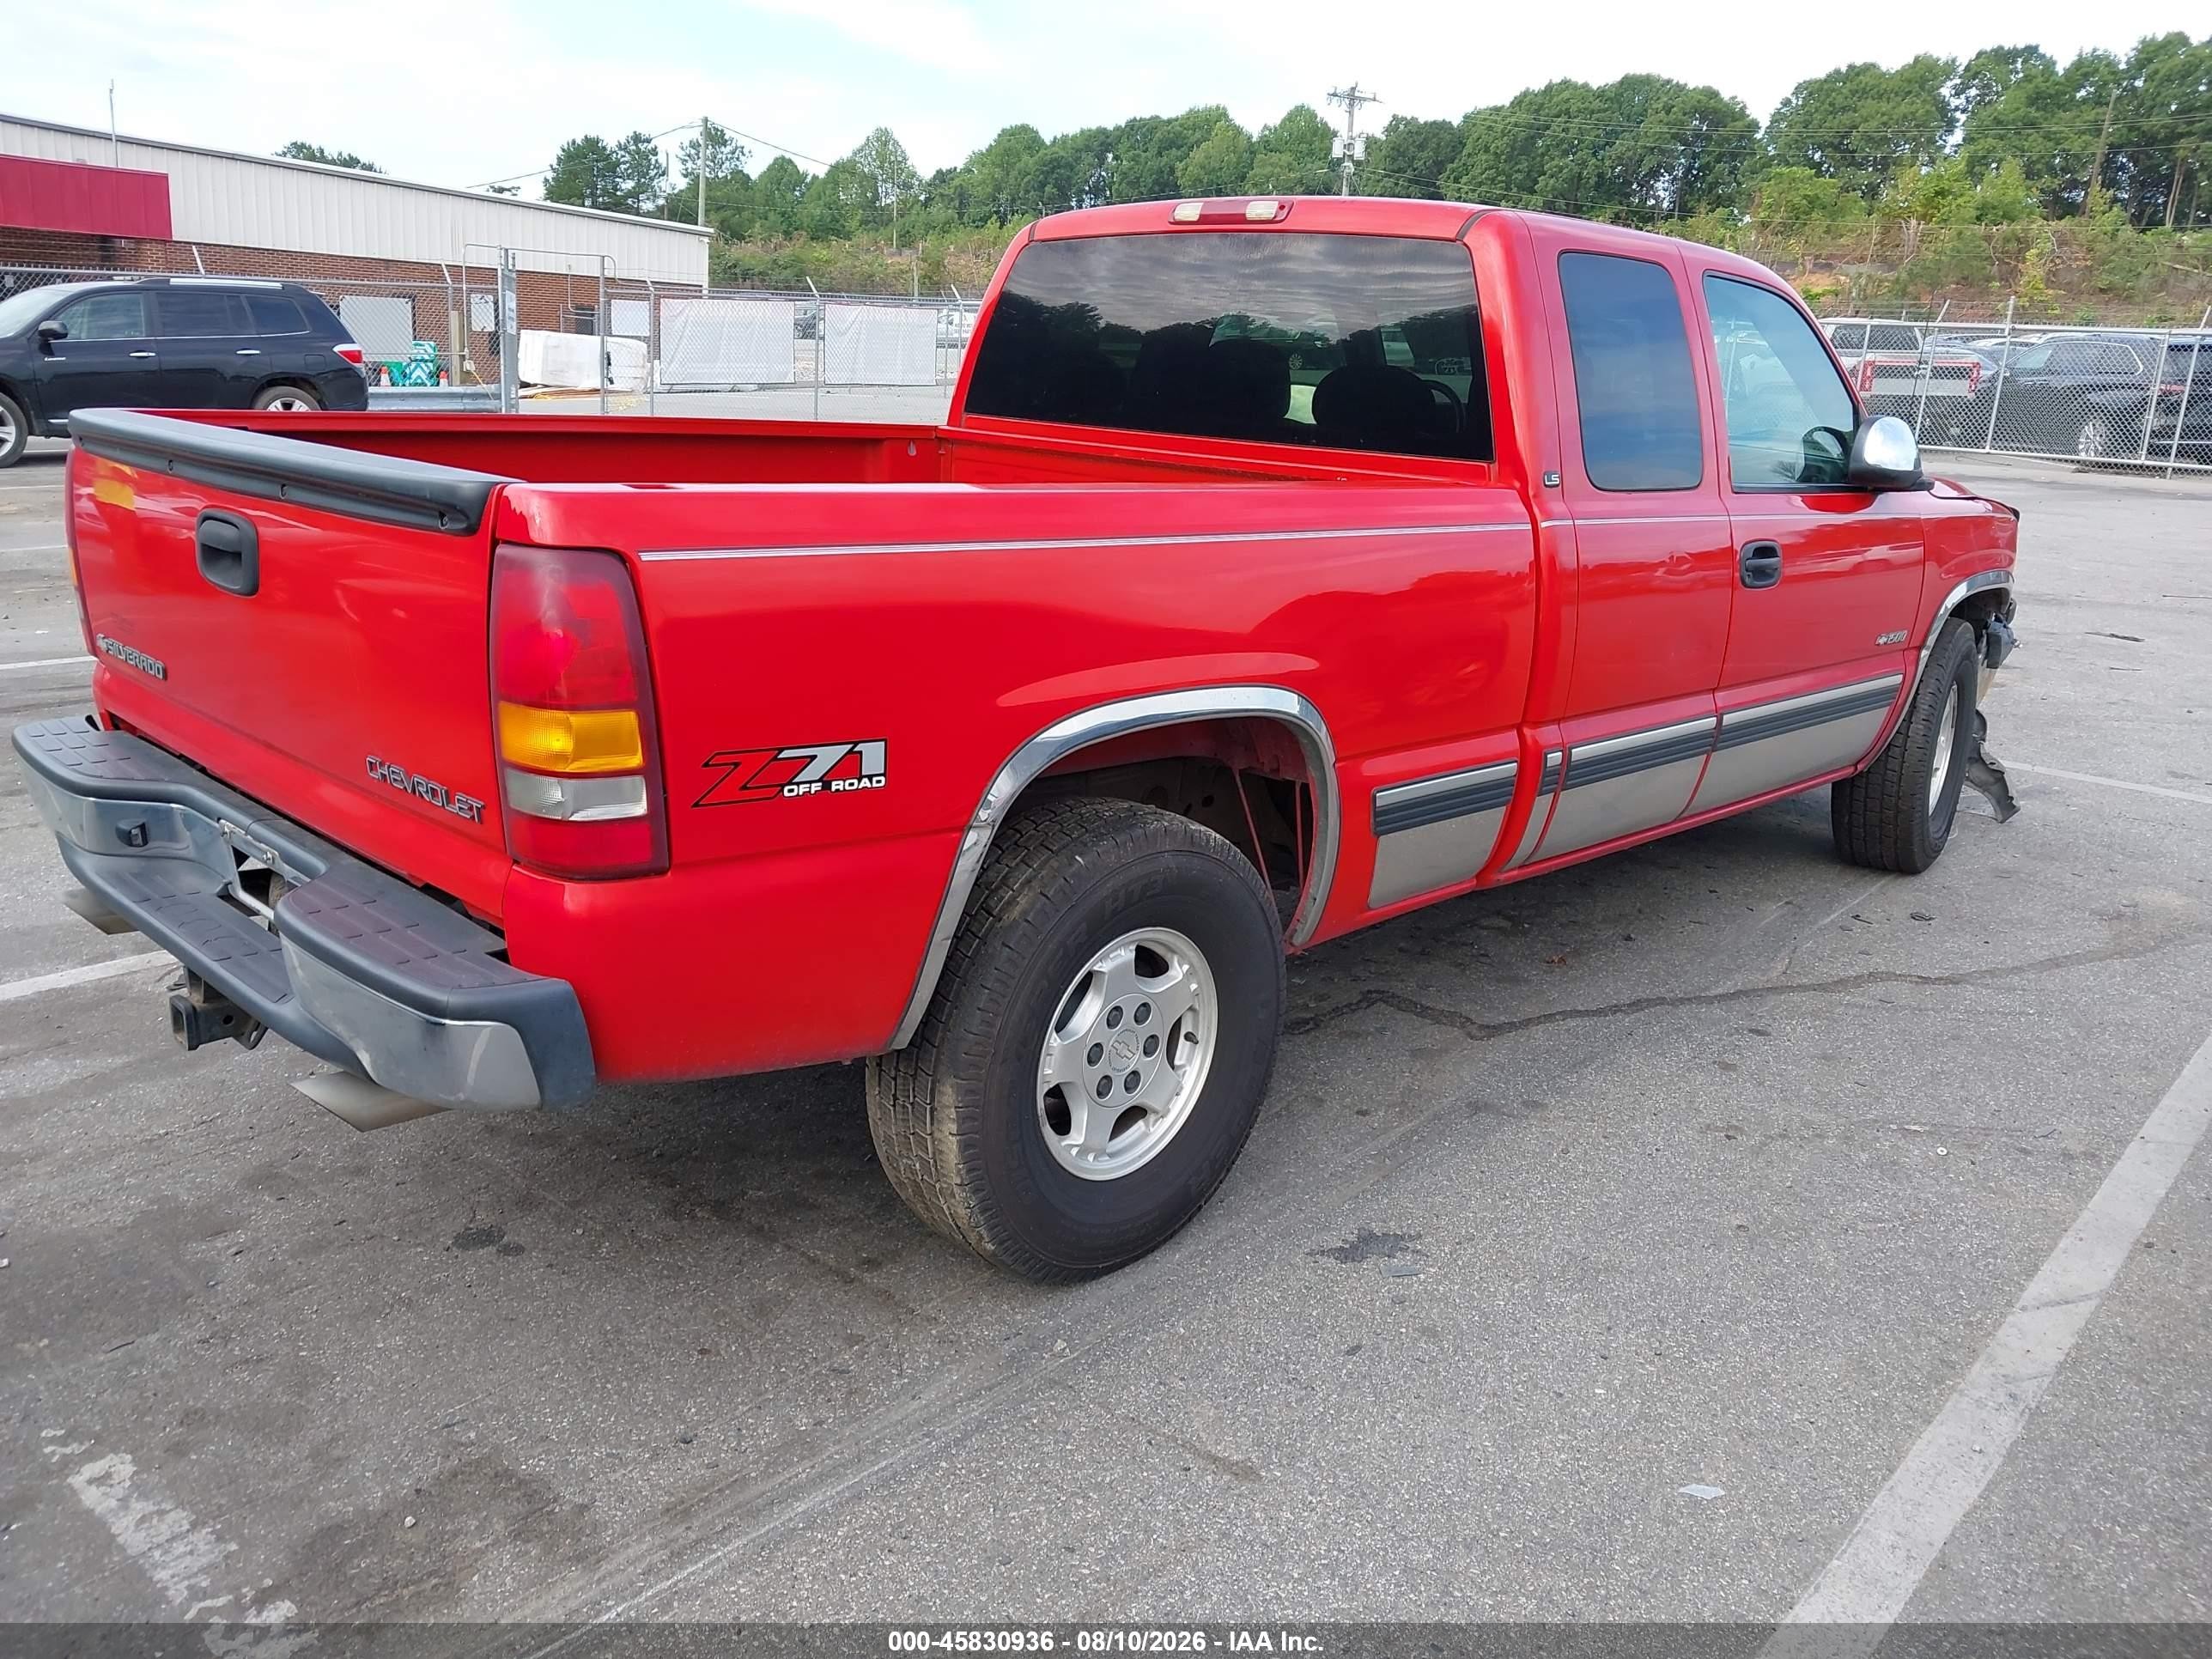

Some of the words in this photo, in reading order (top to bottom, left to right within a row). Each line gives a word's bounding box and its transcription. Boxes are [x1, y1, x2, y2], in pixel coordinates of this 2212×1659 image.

[1544, 473, 1560, 486] LS
[105, 637, 166, 681] SILVERADO
[365, 755, 486, 824] CHEVROLET
[690, 737, 888, 809] Z71
[782, 781, 823, 798] OFF
[830, 775, 886, 793] ROAD
